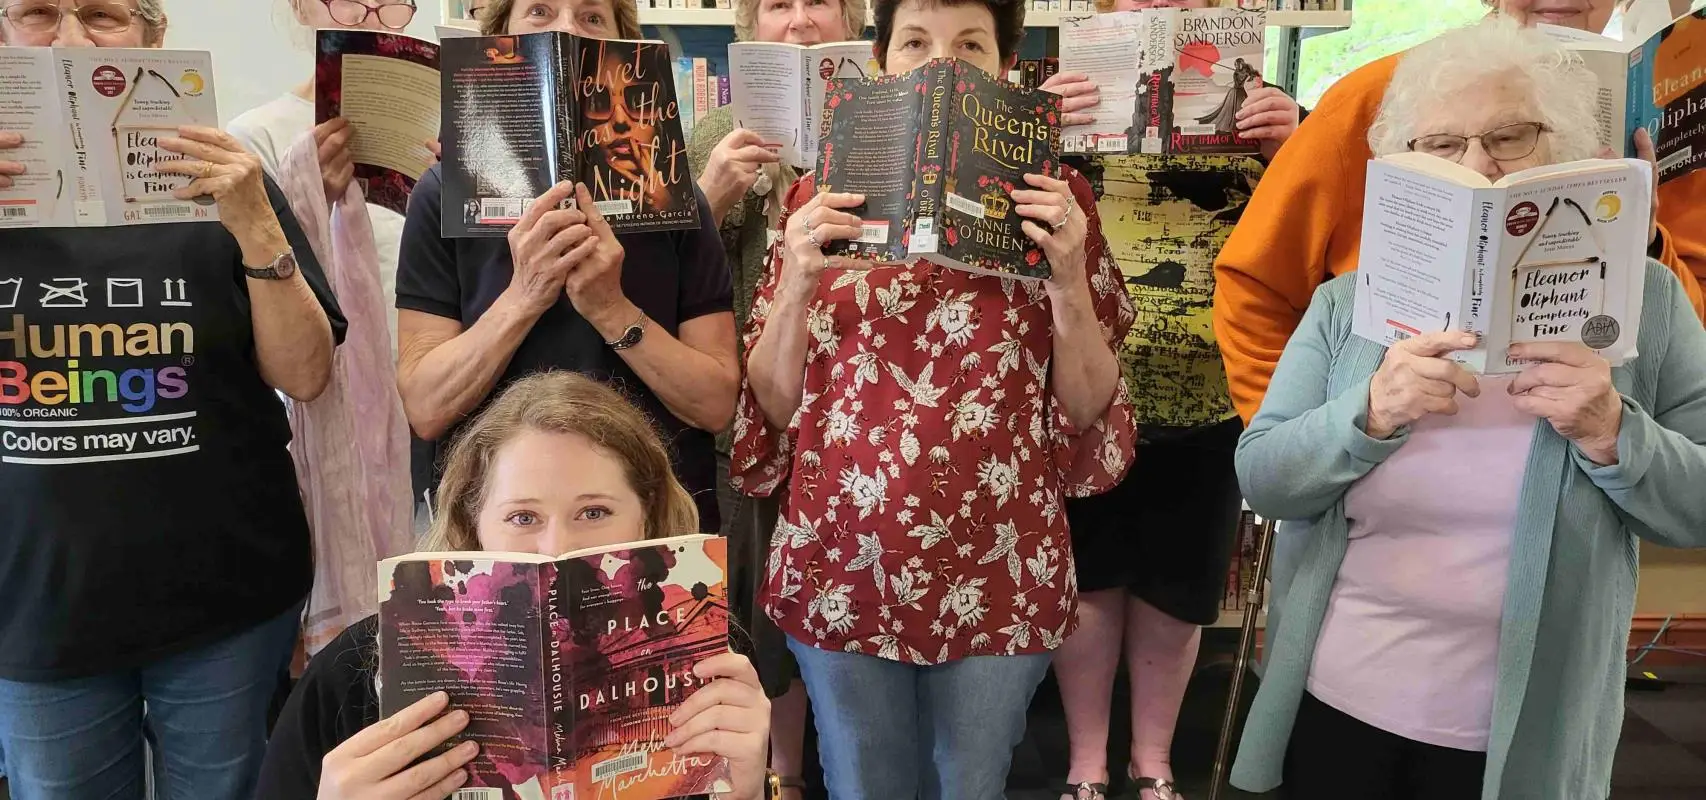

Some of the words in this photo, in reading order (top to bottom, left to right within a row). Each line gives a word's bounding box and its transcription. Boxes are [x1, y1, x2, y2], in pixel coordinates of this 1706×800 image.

[1183, 16, 1254, 33] BRANDON
[1149, 16, 1158, 66] SANDERSON
[1176, 32, 1262, 46] SANDERSON
[570, 40, 652, 102] Velvet
[937, 68, 946, 84] The
[1652, 67, 1706, 104] Elean
[636, 81, 680, 130] the
[931, 86, 946, 128] Queen's
[962, 94, 1048, 140] Queen's
[995, 98, 1013, 114] The
[128, 132, 158, 148] Elea
[574, 123, 612, 154] was
[924, 130, 940, 158] Rival
[972, 127, 1032, 165] Rival
[593, 137, 691, 213] Night
[616, 210, 692, 220] Moreno-Garcia
[973, 218, 1012, 235] ANNE
[1480, 202, 1494, 233] Eleanor
[960, 224, 1024, 252] O'BRIEN
[1477, 234, 1489, 266] Oliphant
[1525, 270, 1589, 289] Eleanor
[1472, 298, 1482, 318] Fine
[1521, 288, 1588, 308] Oliphant
[1529, 308, 1590, 321] Completely
[0, 314, 194, 358] Human
[1534, 324, 1569, 337] Fine
[0, 360, 188, 412] Beings
[0, 408, 20, 418] 100%
[22, 408, 78, 418] ORGANIC
[2, 430, 78, 452] Colors
[84, 432, 137, 452] may
[143, 426, 196, 446] vary.
[637, 578, 652, 591] the
[548, 589, 559, 628] PLACE
[607, 607, 685, 635] PLACE
[550, 640, 562, 712] DALHOUSIE
[619, 729, 666, 757] Melin
[598, 754, 712, 800] Marchetta
